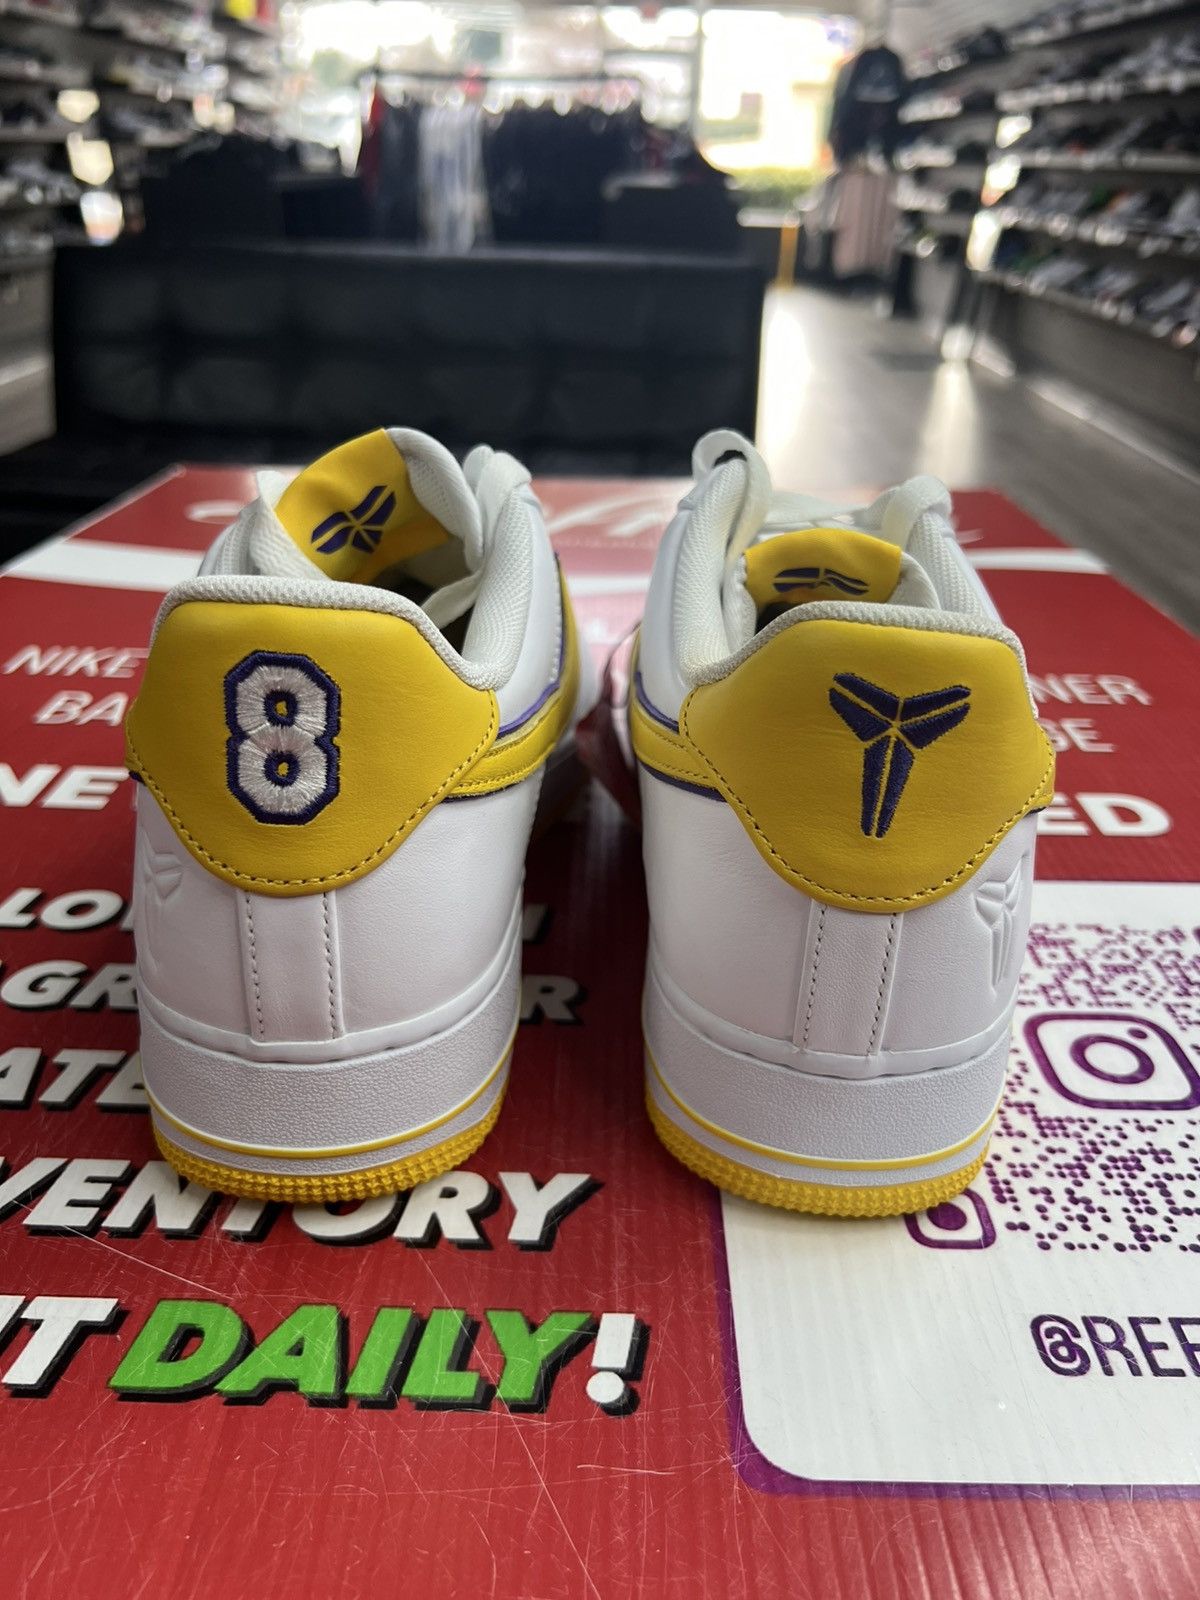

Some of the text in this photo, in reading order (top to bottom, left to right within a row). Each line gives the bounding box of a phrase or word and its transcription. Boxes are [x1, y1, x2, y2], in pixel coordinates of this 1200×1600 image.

[2, 645, 149, 678] NIKE
[224, 650, 341, 825] 8
[0, 888, 134, 931] LO
[108, 1299, 642, 1408] DAILY!
